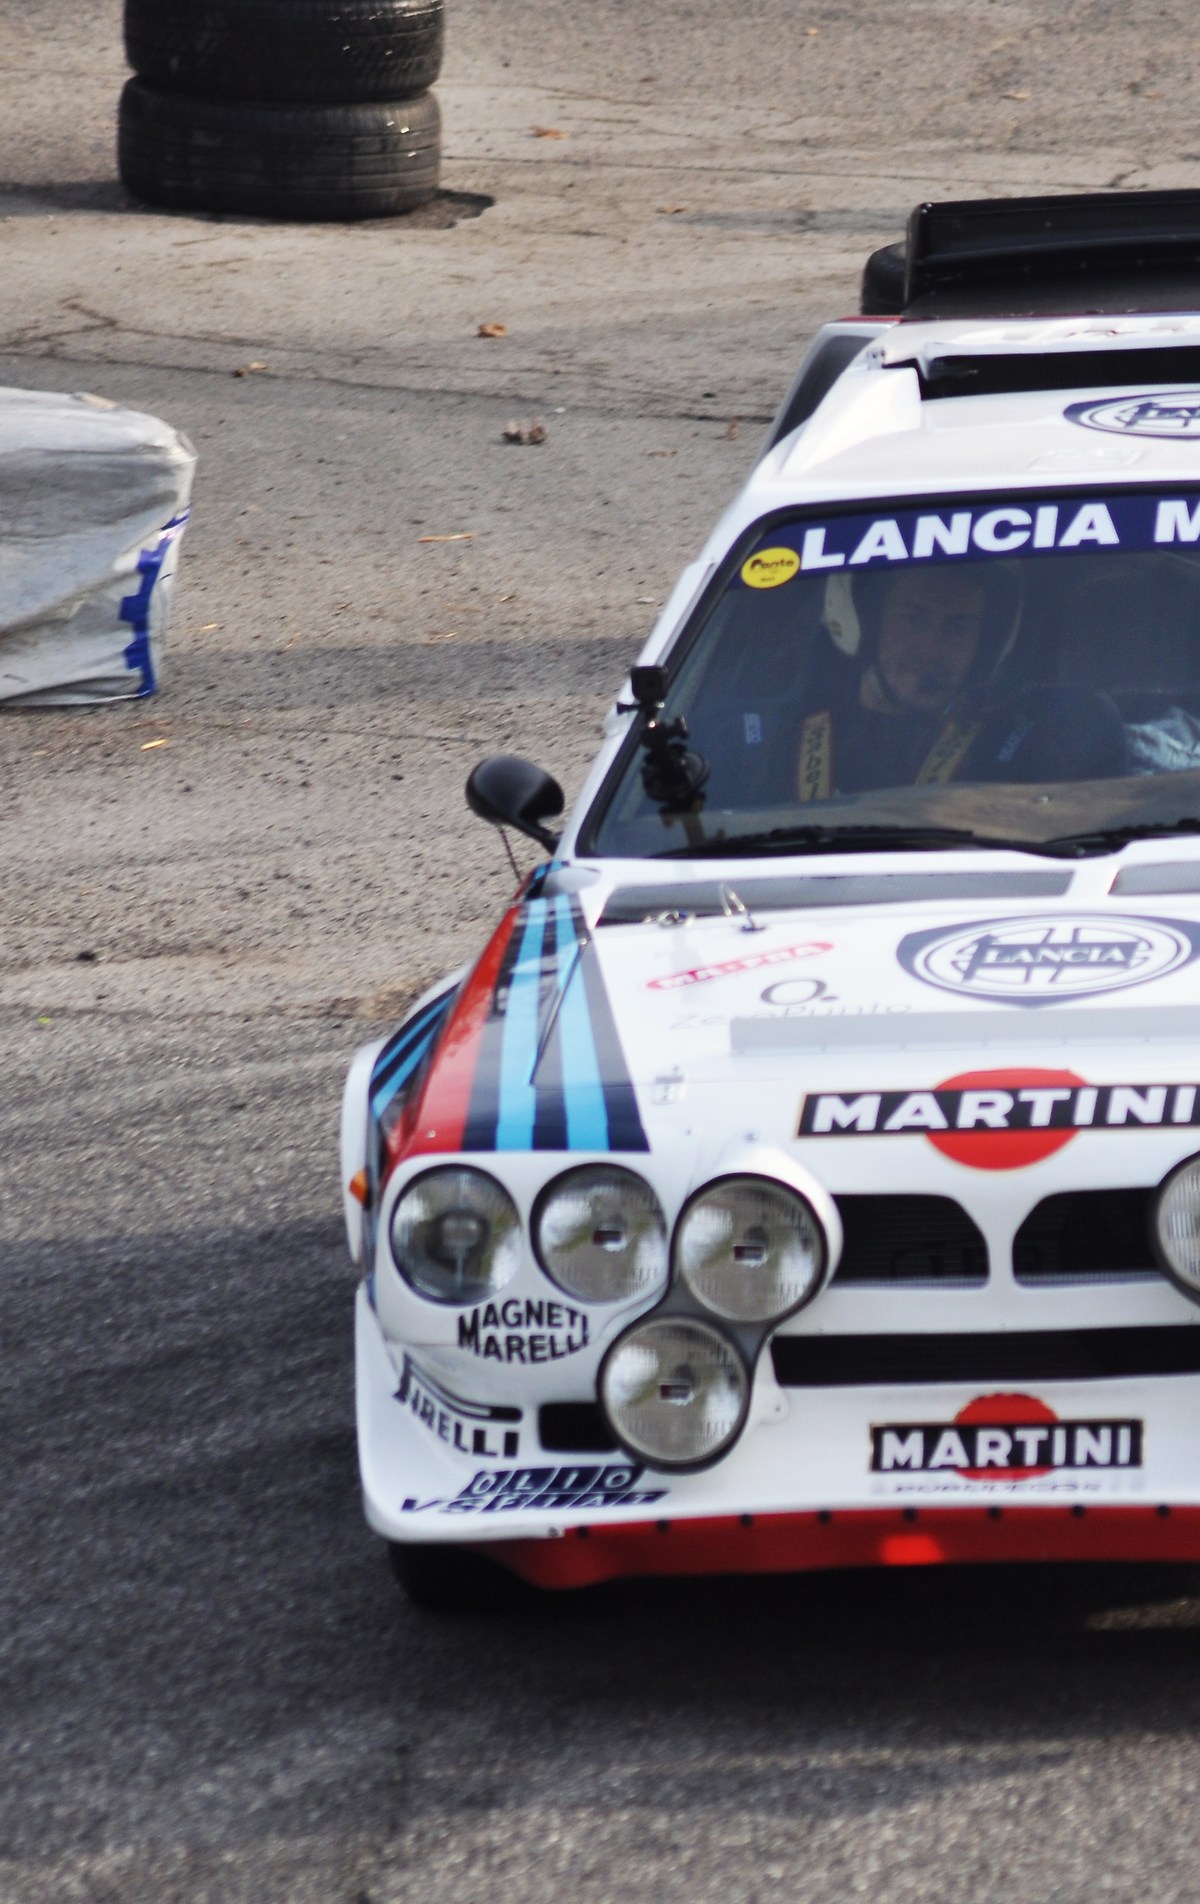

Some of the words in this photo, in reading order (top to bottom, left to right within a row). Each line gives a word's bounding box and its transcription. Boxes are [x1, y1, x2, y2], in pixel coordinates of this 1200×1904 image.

[801, 503, 1120, 570] LANCIA
[984, 946, 1126, 965] LANCIA
[812, 1086, 1197, 1132] MARTINI
[458, 1299, 589, 1338] MAGNETI
[458, 1322, 589, 1364] MARELLI
[393, 1352, 522, 1458] PIRELLI
[880, 1426, 1132, 1470] MARTINI
[466, 1467, 642, 1496] OLIO
